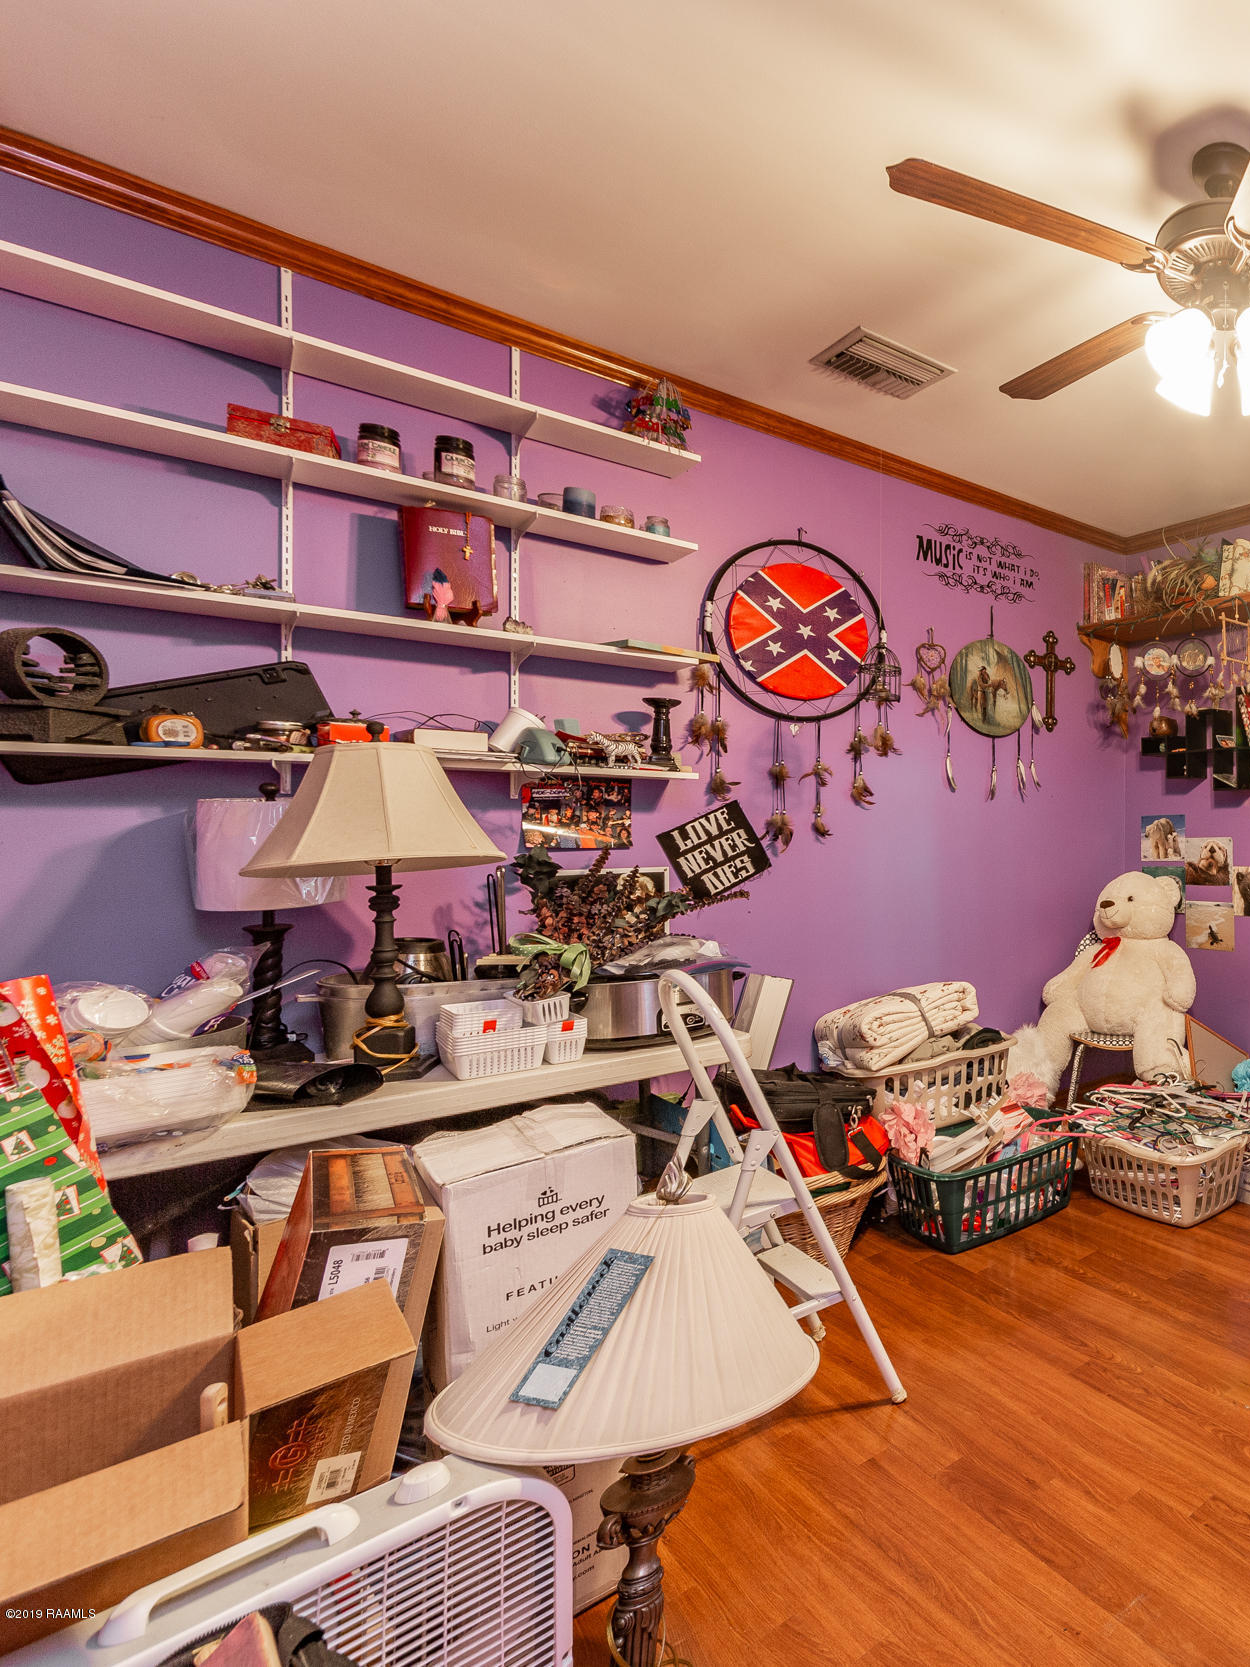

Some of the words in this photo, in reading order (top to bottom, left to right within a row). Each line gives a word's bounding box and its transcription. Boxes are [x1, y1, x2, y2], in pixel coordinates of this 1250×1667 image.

[428, 525, 449, 534] HOLY
[977, 553, 993, 566] NOT
[996, 560, 1020, 575] WHAT
[991, 569, 1010, 582] WHO
[670, 807, 736, 853] LOVE
[676, 828, 756, 878] NEVER
[700, 854, 756, 896] DIES
[482, 1235, 524, 1255] baby
[526, 1220, 569, 1241] sleep
[572, 1208, 610, 1227] safer
[486, 1209, 556, 1238] Helping
[559, 1195, 605, 1216] every
[328, 1259, 344, 1286] L5048
[486, 1319, 510, 1333] Light
